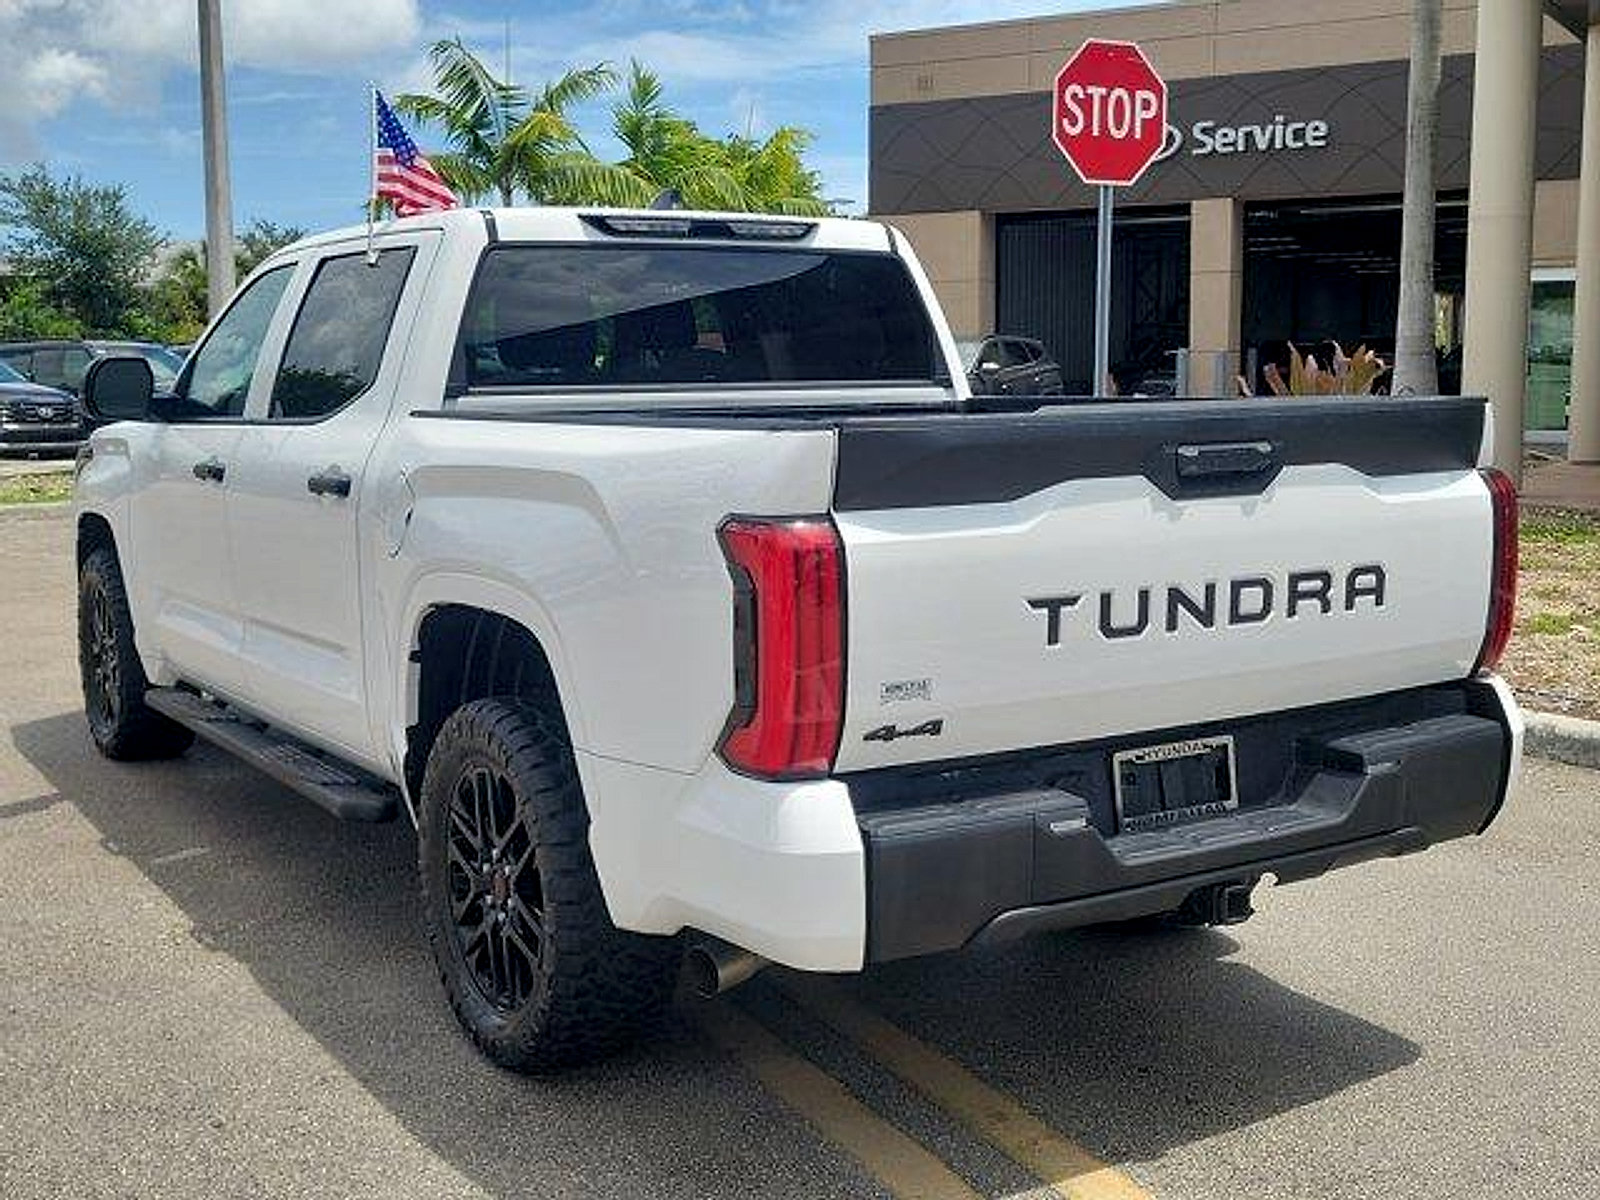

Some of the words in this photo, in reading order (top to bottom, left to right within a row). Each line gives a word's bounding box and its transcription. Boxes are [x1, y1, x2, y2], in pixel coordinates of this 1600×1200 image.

[1062, 84, 1159, 139] STOP
[1192, 115, 1329, 155] Service
[1025, 564, 1386, 646] TUNDRA
